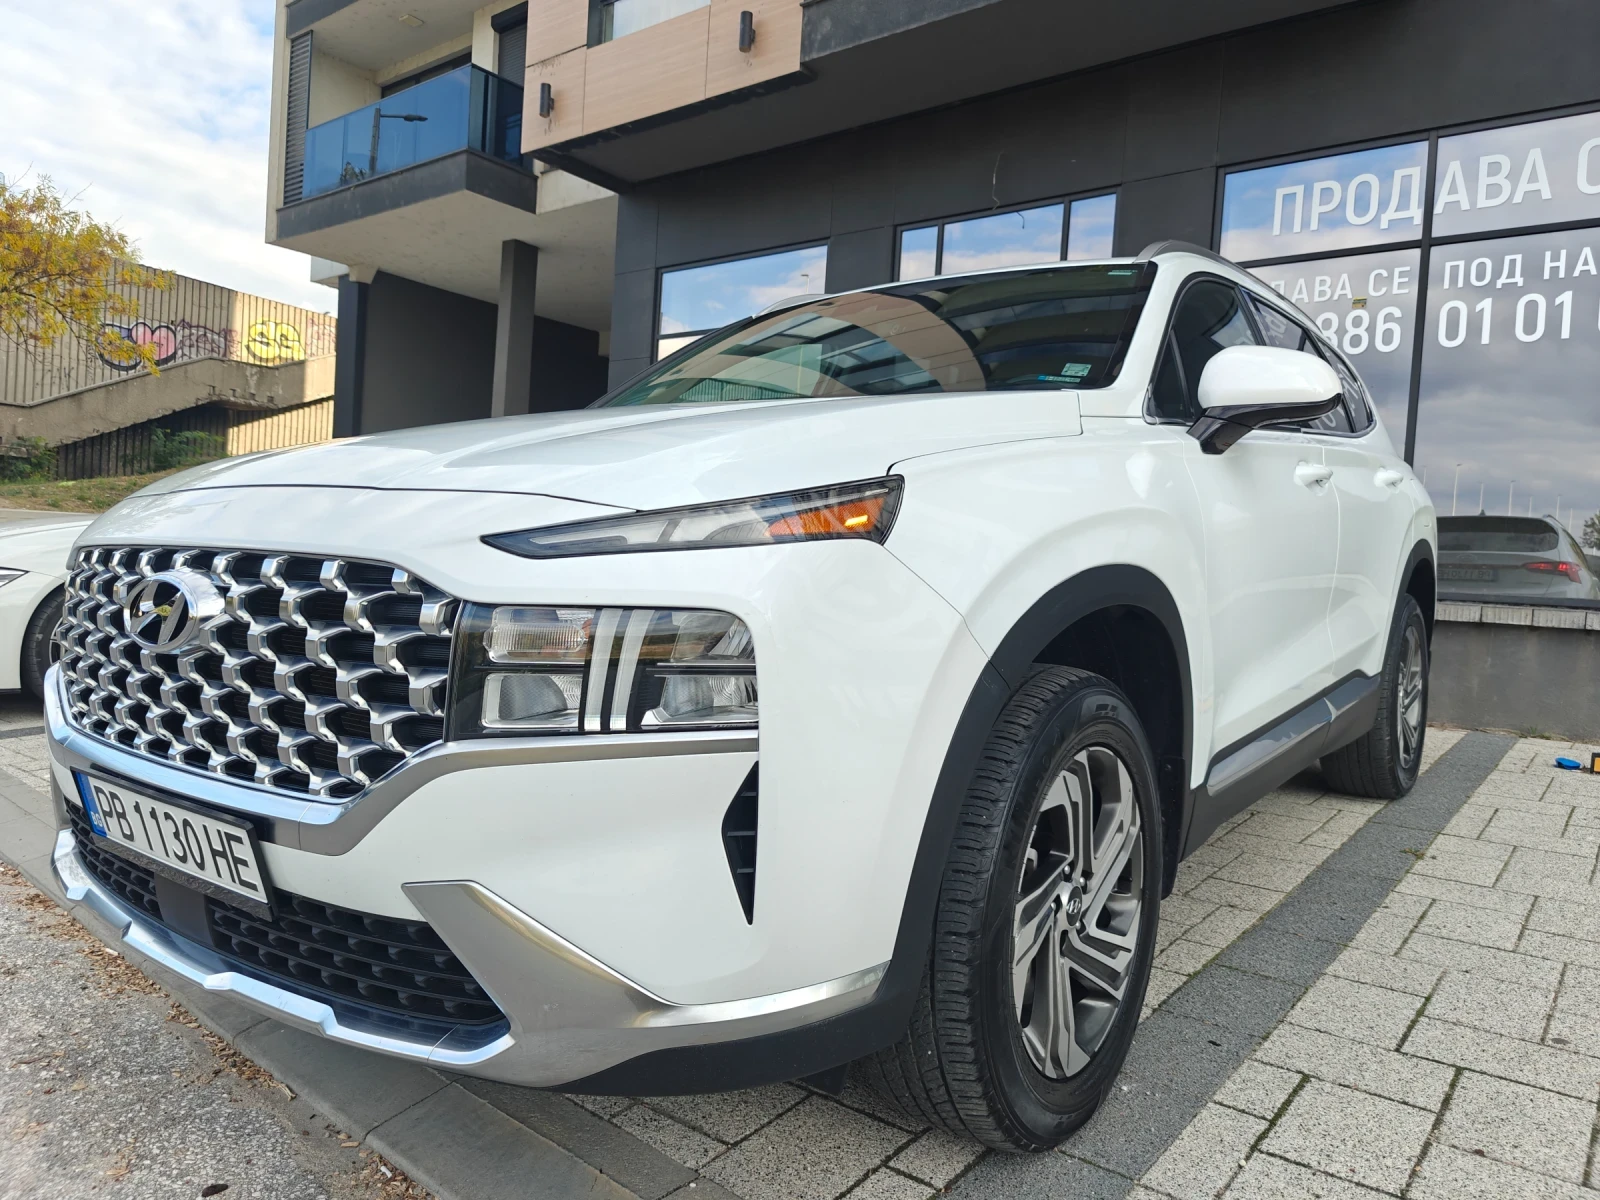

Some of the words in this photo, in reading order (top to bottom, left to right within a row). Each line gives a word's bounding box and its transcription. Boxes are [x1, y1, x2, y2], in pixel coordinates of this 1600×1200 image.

[1271, 147, 1552, 236] ПРОДАВА
[1368, 266, 1411, 297] СЕ
[1443, 253, 1524, 290] ПОД
[1543, 246, 1598, 280] НА
[1437, 298, 1493, 348] 01
[1515, 290, 1573, 343] 01
